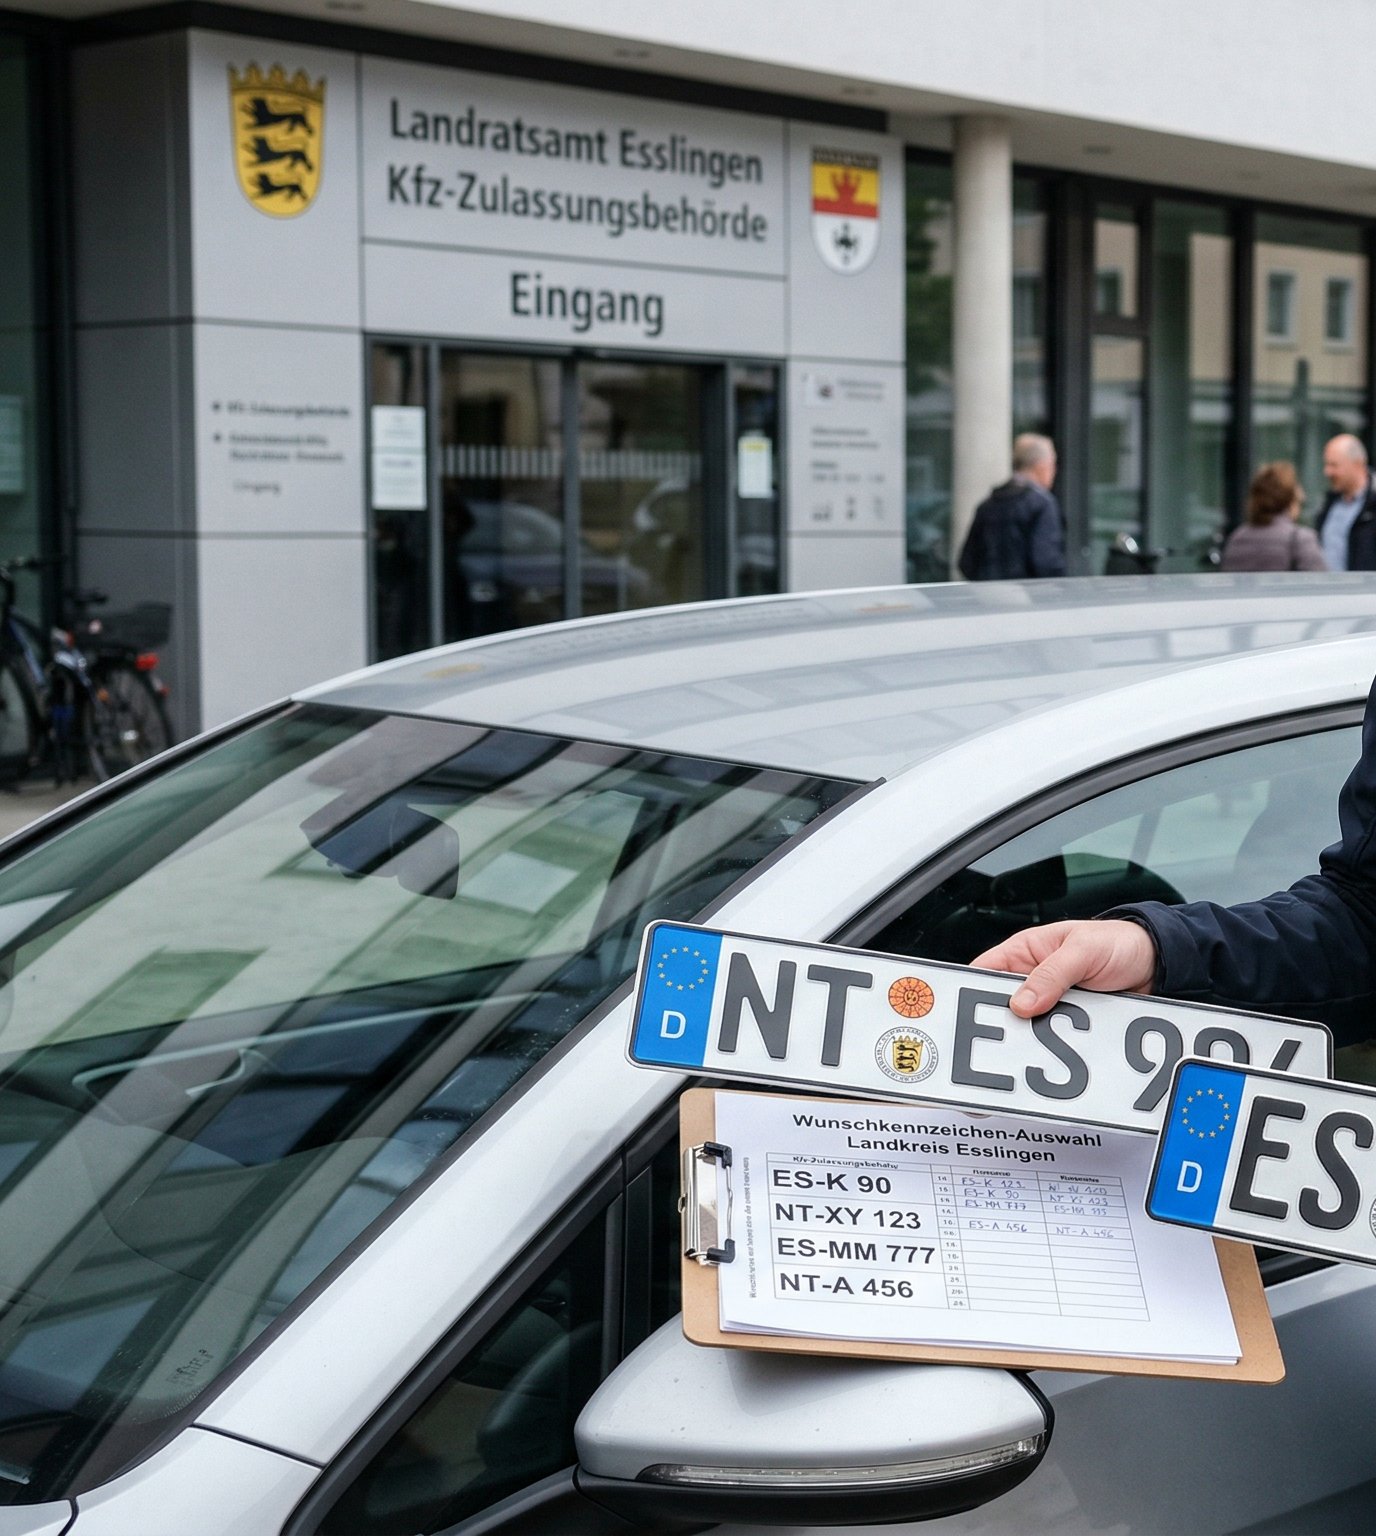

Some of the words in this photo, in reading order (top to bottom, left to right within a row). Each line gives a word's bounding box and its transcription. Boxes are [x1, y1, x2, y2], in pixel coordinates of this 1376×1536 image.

[390, 98, 609, 165] Landratsamt
[620, 130, 763, 189] Esslingen
[387, 163, 769, 243] Kfz-Zulassungsbehörde
[511, 271, 665, 338] Eingang
[659, 1009, 687, 1040] D
[716, 952, 873, 1069] NT
[950, 986, 1091, 1101] ES
[792, 1112, 1103, 1149] Wunschkennzeichen-Auswahl
[846, 1135, 951, 1156] Landkreis
[956, 1142, 1056, 1163] Esslingen
[1229, 1096, 1375, 1231] ES
[773, 1169, 849, 1192] ES-K
[857, 1175, 892, 1194] 90
[1176, 1159, 1203, 1195] D
[775, 1203, 863, 1226] NT-XY
[873, 1209, 922, 1230] 123
[777, 1237, 878, 1261] ES-MM
[886, 1244, 936, 1264] 777
[780, 1272, 855, 1295] NT-A
[862, 1278, 914, 1298] 456
